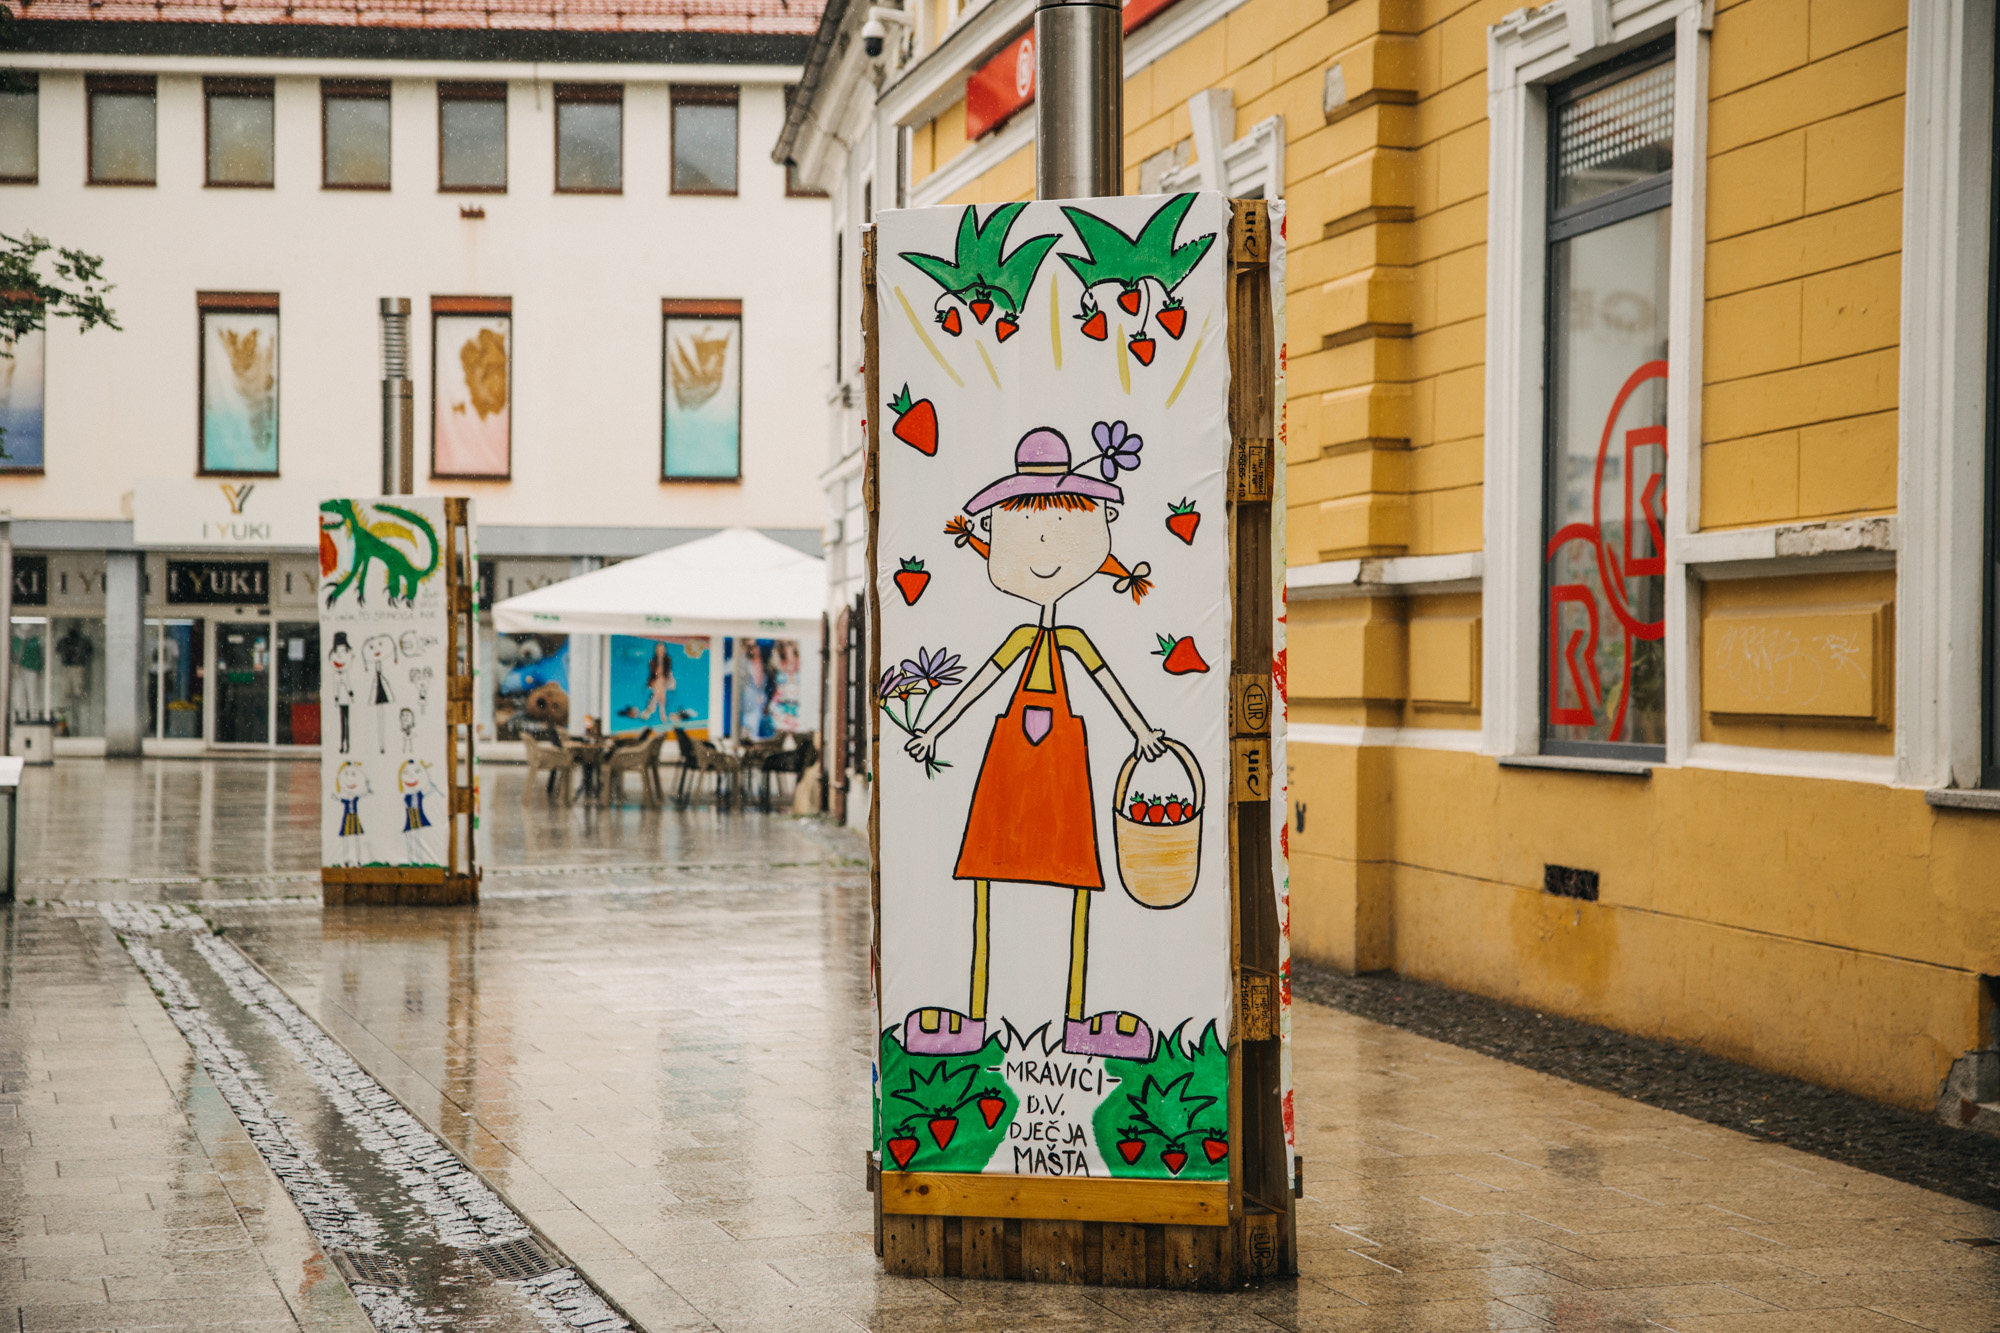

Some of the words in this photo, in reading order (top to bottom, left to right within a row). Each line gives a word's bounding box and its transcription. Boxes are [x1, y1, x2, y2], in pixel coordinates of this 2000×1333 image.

[216, 522, 271, 541] YUKI
[170, 571, 179, 594] I
[189, 568, 262, 594] YUKI
[1247, 693, 1264, 720] EUR
[1010, 1120, 1088, 1147] DJEČJA
[1013, 1143, 1090, 1178] MAŠTA
